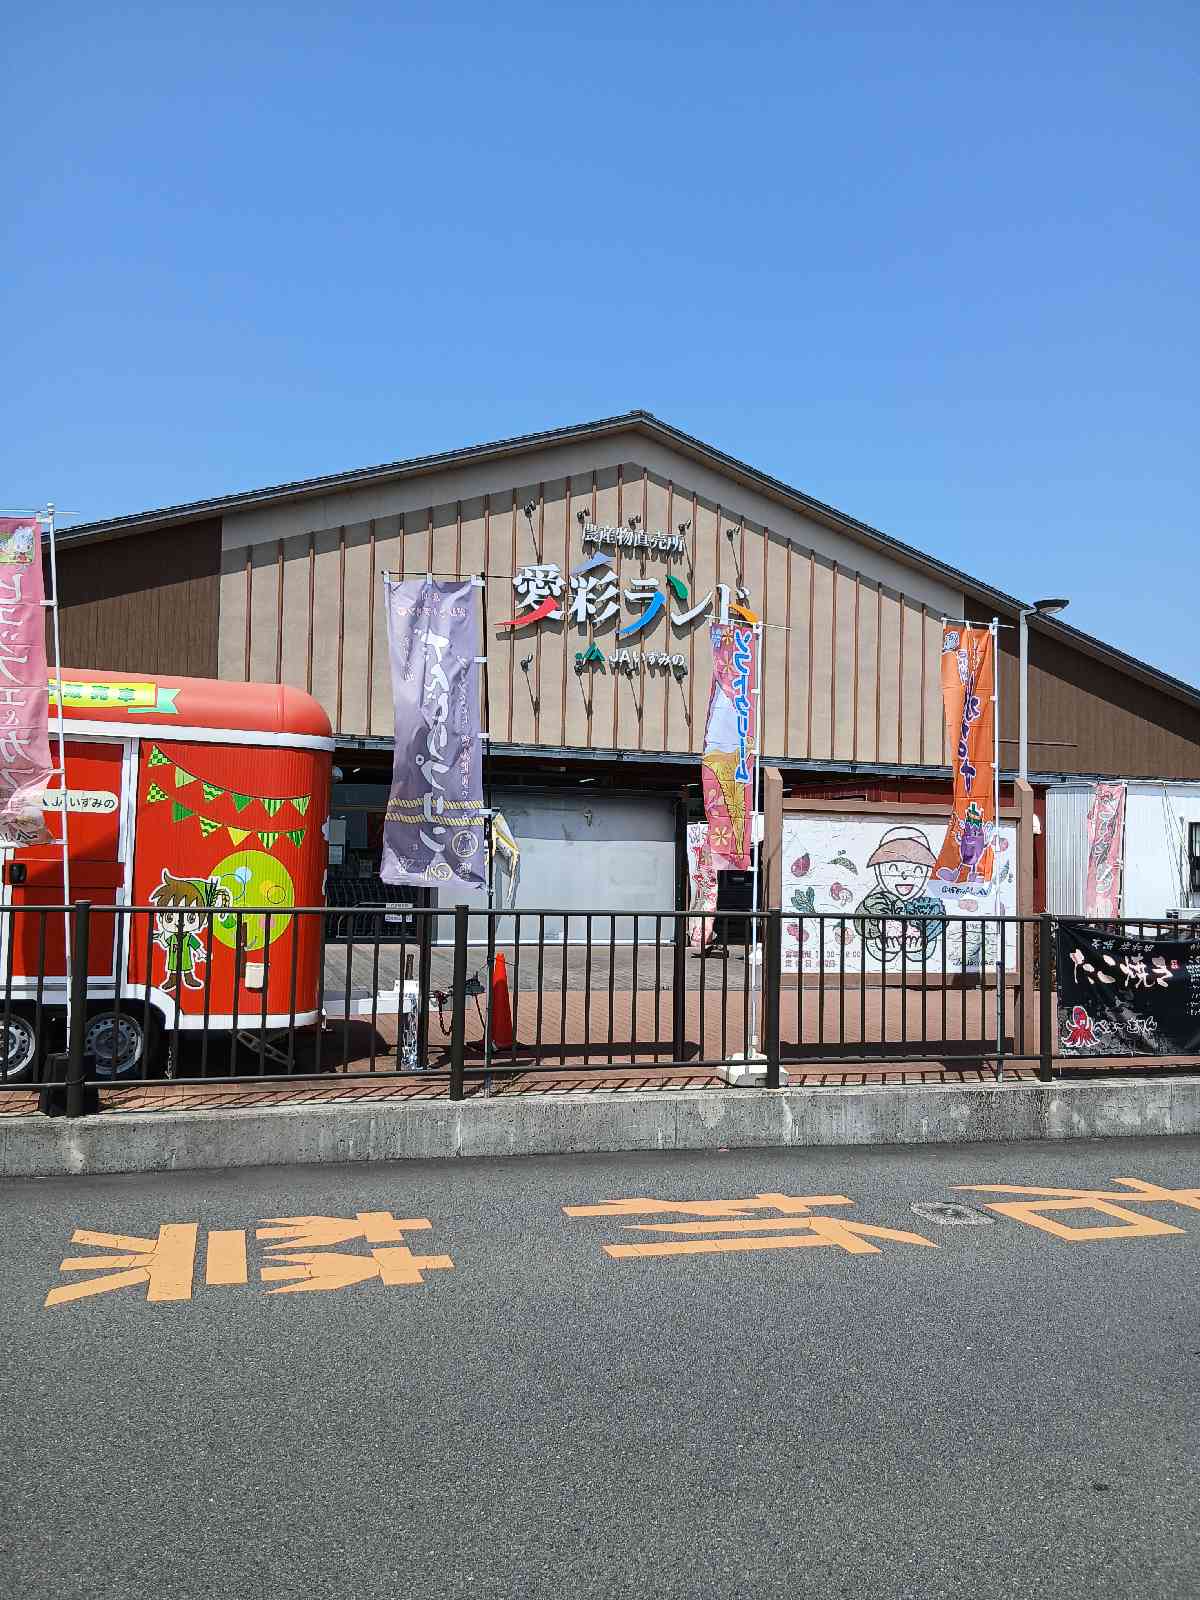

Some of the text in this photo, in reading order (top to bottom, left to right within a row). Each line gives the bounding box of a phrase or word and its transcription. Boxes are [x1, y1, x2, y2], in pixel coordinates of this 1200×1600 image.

[583, 523, 685, 552] 農産物直売所
[495, 551, 759, 639] 愛彩ランド
